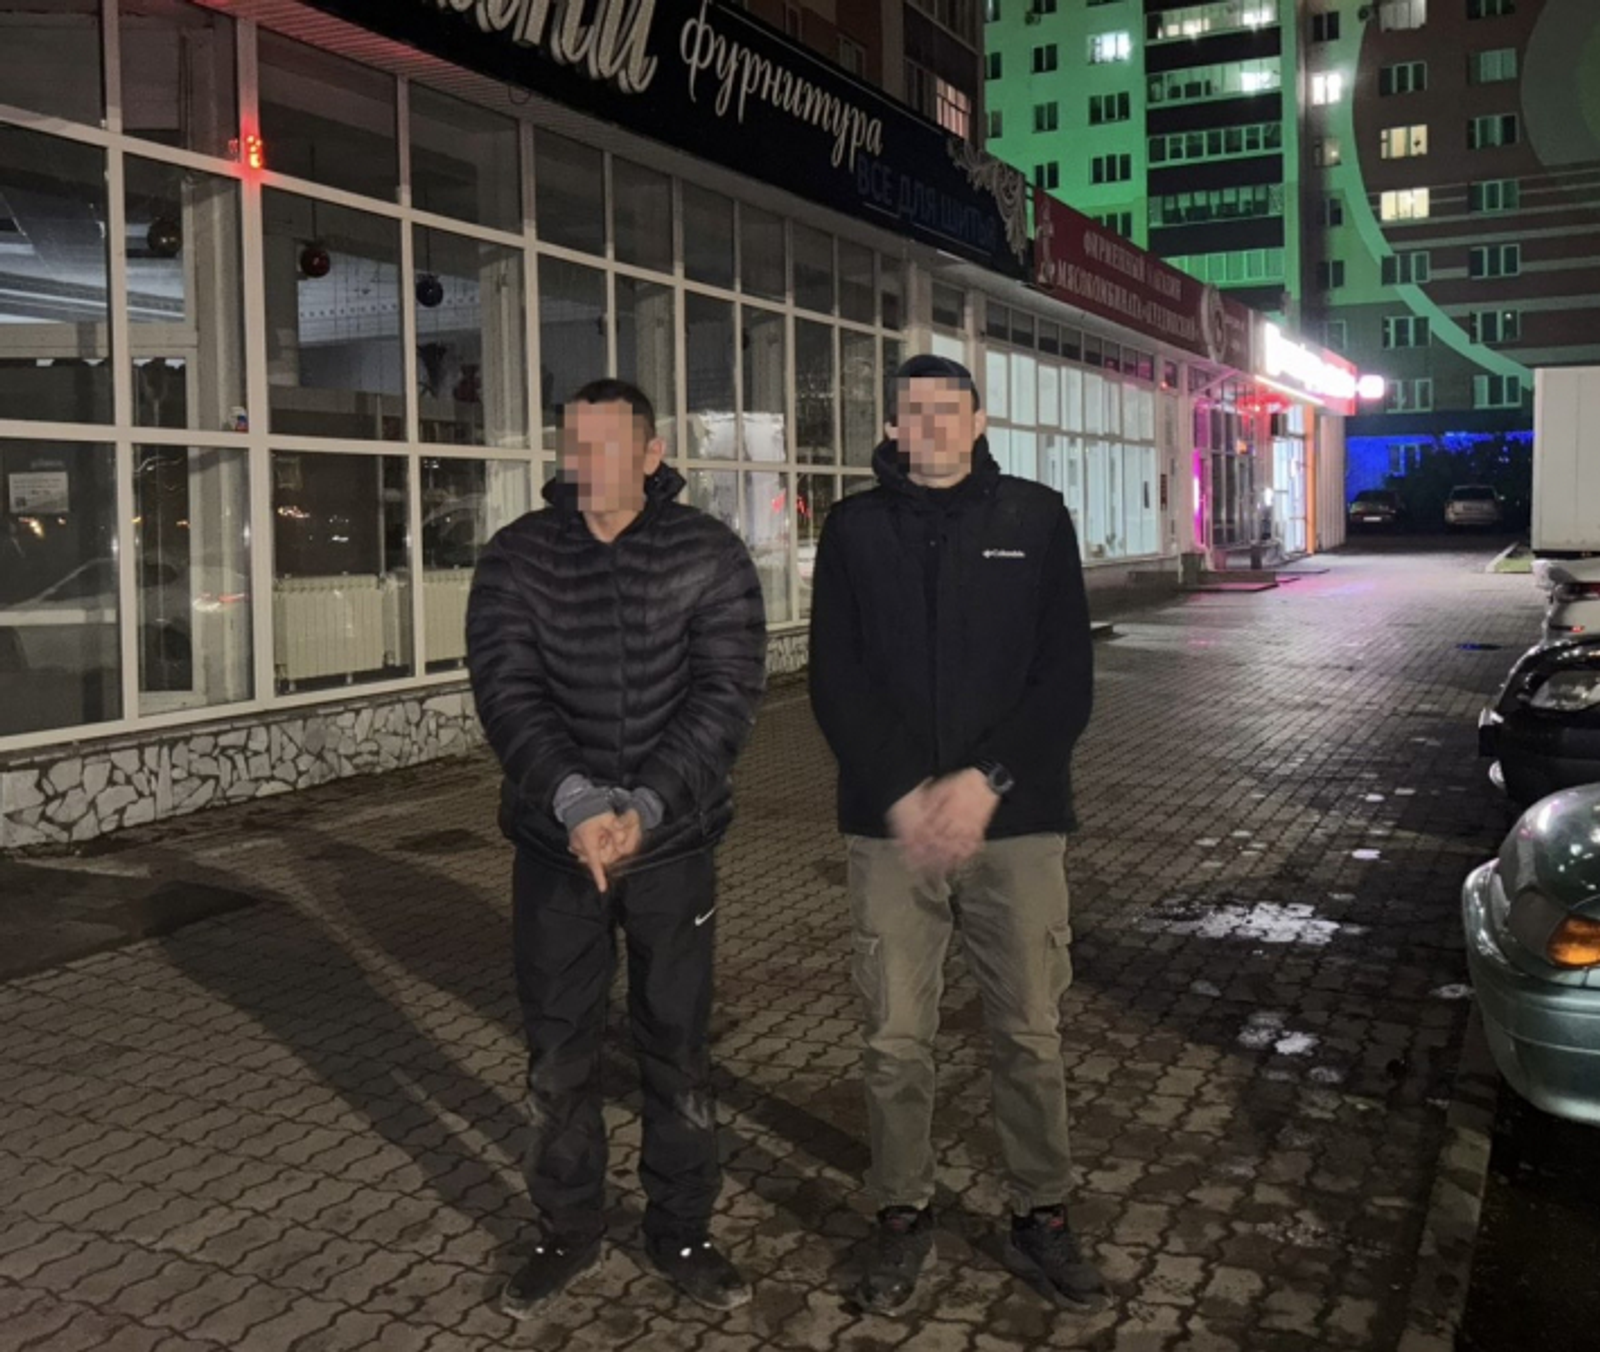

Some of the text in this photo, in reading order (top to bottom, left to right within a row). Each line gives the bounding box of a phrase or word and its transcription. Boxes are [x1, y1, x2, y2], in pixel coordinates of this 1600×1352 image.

[680, 0, 885, 175] фурнитура
[857, 151, 894, 206] ВСЕ
[898, 173, 937, 226] ДЛЯ
